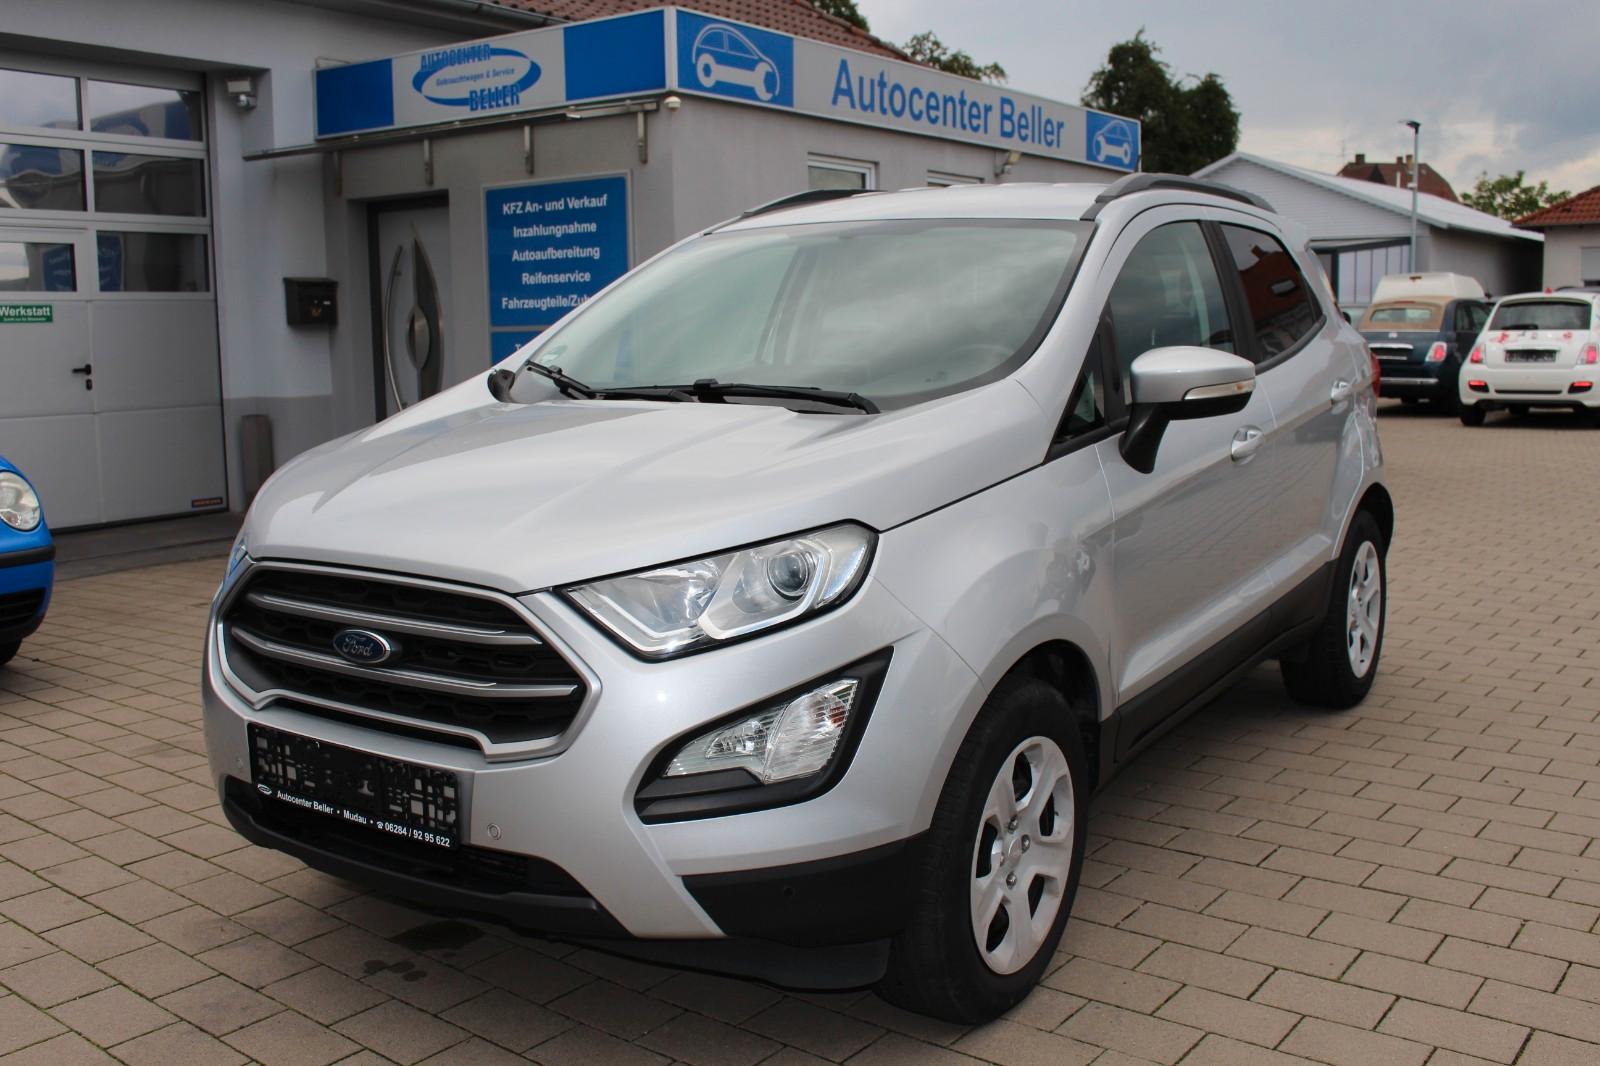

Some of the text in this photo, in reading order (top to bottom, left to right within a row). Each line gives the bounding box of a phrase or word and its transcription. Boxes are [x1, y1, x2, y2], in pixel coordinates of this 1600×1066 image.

[420, 43, 491, 71] AUTOCENTER
[492, 67, 515, 79] Service
[469, 83, 520, 112] BELLER
[831, 58, 1065, 148] Autocenter Beller
[502, 194, 608, 215] KFZ An- und Verkauf
[513, 221, 597, 238] Inzahlungnahme
[512, 246, 600, 262] Autoaufbereitung
[522, 270, 591, 285] Reifenservice
[0, 306, 51, 317] Werkstatt
[342, 636, 374, 656] Ford
[277, 790, 312, 809] Autocenter
[313, 800, 333, 814] Beller
[343, 809, 367, 825] Mudau
[384, 821, 408, 837] 06284
[413, 829, 423, 840] 92
[424, 832, 434, 843] 95
[435, 835, 451, 848] 622
